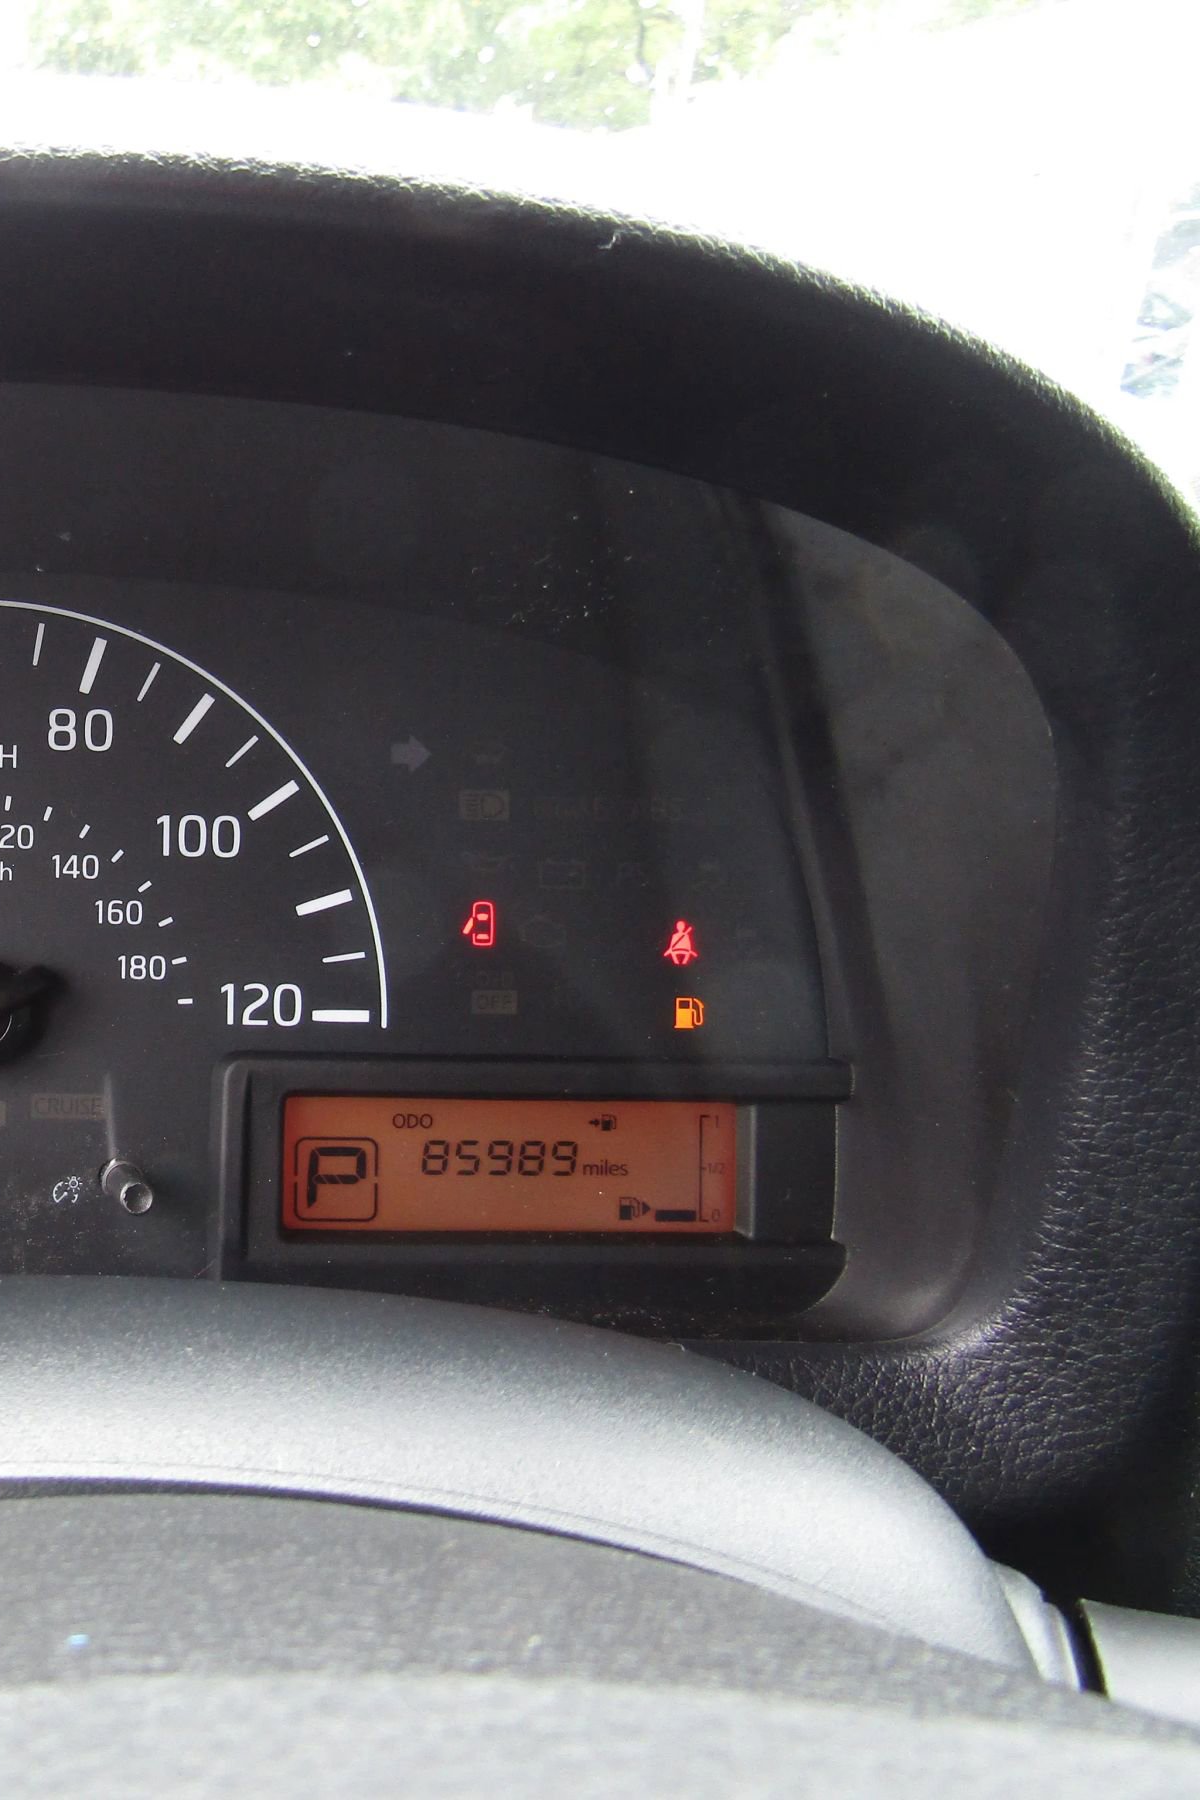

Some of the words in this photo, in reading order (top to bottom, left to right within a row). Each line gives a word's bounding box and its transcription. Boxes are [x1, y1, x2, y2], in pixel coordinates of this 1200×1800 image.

[48, 709, 112, 751] 80
[157, 815, 240, 857] 100
[52, 855, 98, 879] 140
[95, 900, 142, 924] 160
[118, 956, 165, 980] 180
[221, 983, 301, 1026] 120
[392, 1113, 434, 1129] ODO
[306, 1146, 367, 1208] P
[421, 1139, 578, 1176] 85989
[582, 1159, 629, 1177] miles
